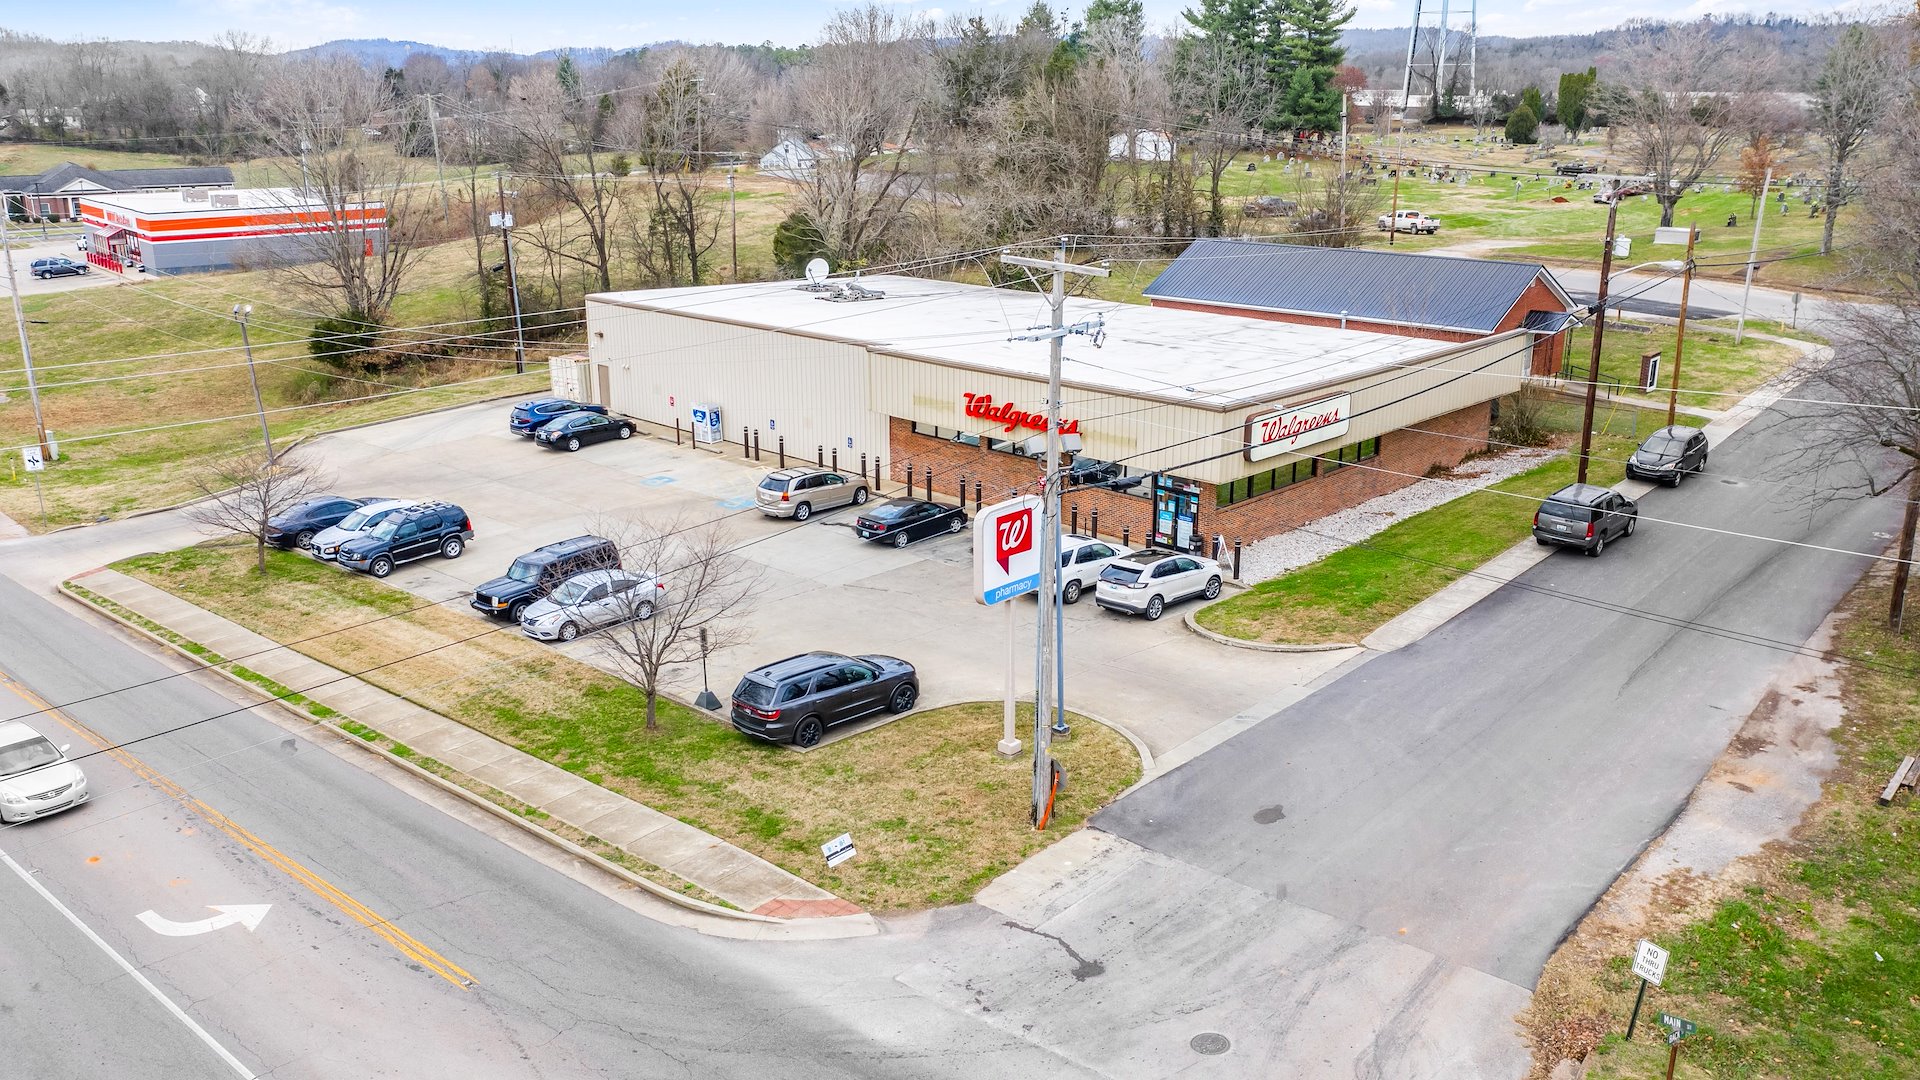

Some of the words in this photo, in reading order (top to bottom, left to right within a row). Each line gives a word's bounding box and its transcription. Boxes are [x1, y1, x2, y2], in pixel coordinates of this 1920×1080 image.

[1261, 407, 1341, 445] Walgreens
[999, 513, 1029, 551] W
[995, 579, 1033, 602] pharmacy
[1642, 956, 1659, 969] THRU
[1646, 948, 1658, 959] NO
[1636, 962, 1660, 980] TRUCKS
[1663, 1015, 1681, 1028] MAIN
